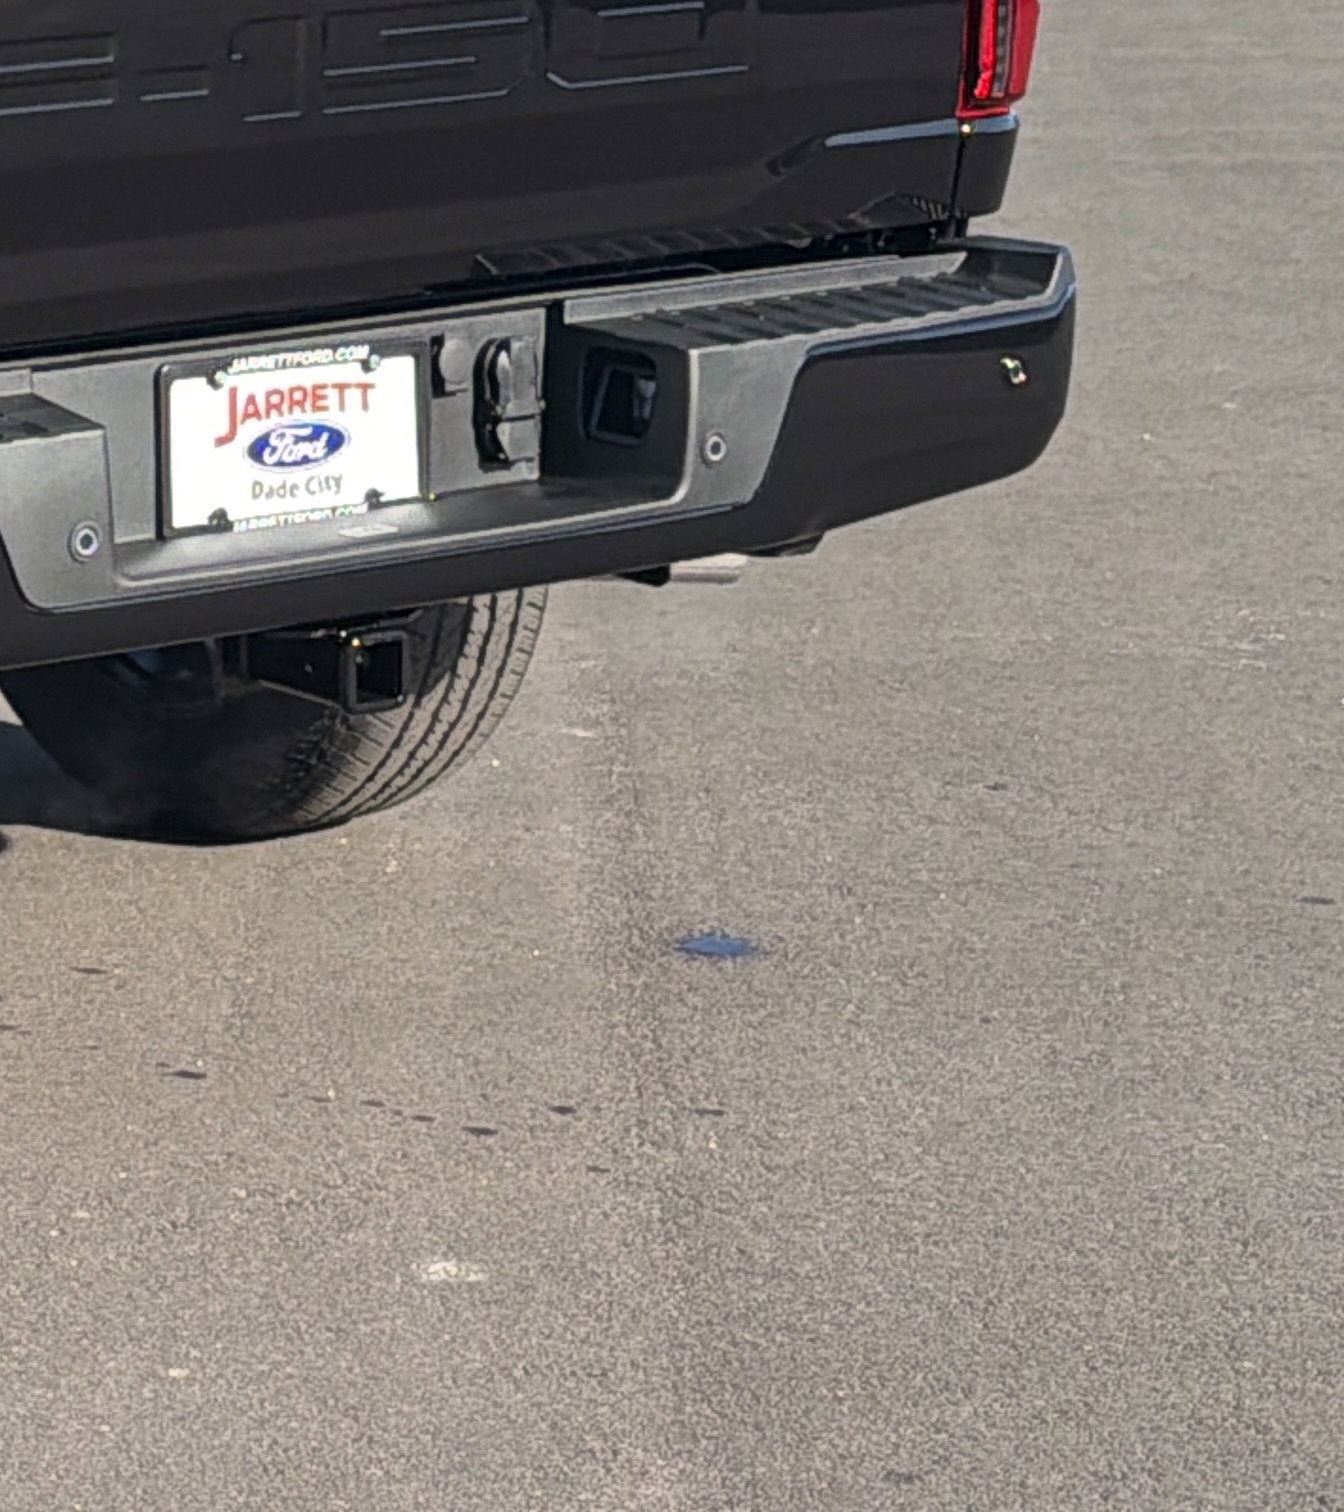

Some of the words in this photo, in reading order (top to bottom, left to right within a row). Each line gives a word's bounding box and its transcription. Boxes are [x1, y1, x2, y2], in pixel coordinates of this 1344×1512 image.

[214, 383, 376, 447] JARRETT
[263, 426, 329, 465] Ford
[252, 479, 299, 499] Dade
[305, 475, 343, 495] City
